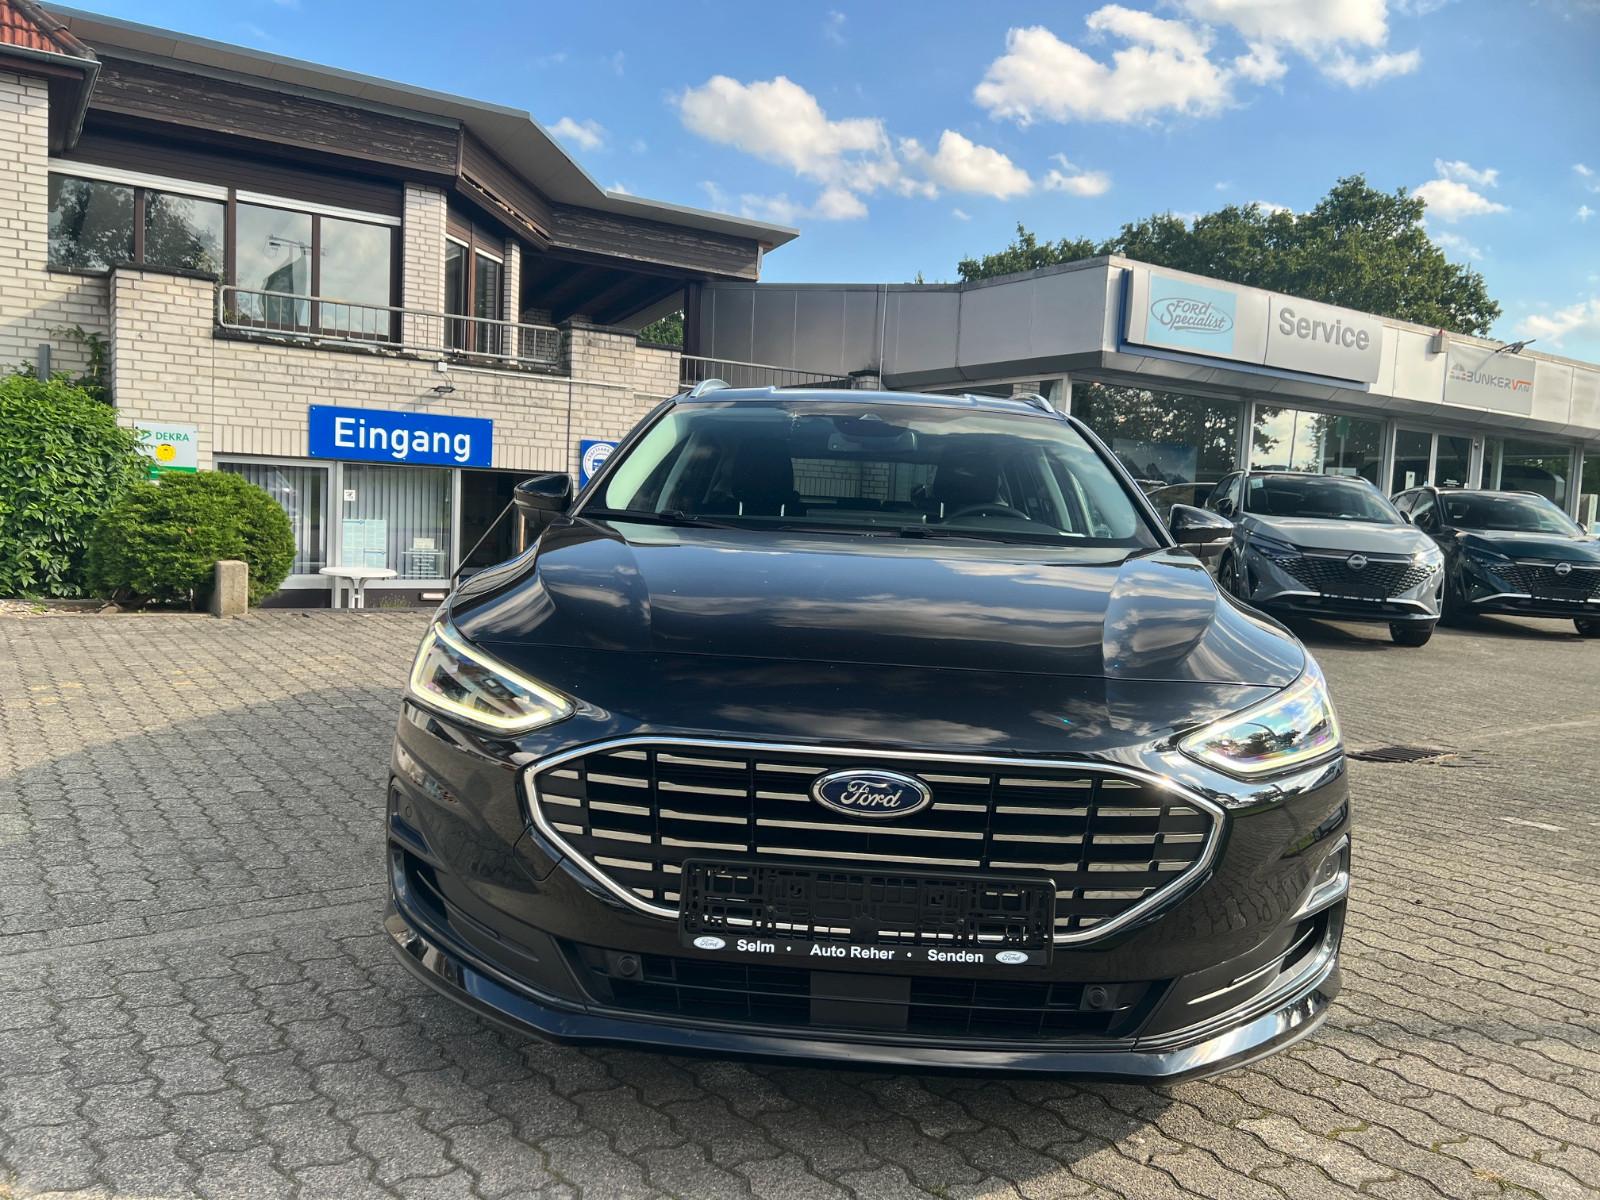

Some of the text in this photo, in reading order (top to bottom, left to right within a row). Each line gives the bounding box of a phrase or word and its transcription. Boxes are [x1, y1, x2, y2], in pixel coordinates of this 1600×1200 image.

[1160, 303, 1225, 331] Specialist
[1280, 307, 1370, 350] Service
[155, 431, 190, 441] DEKRA
[334, 416, 471, 462] Eingang
[840, 780, 903, 808] Ford
[736, 939, 984, 963] Selm Auto Reher Senden
